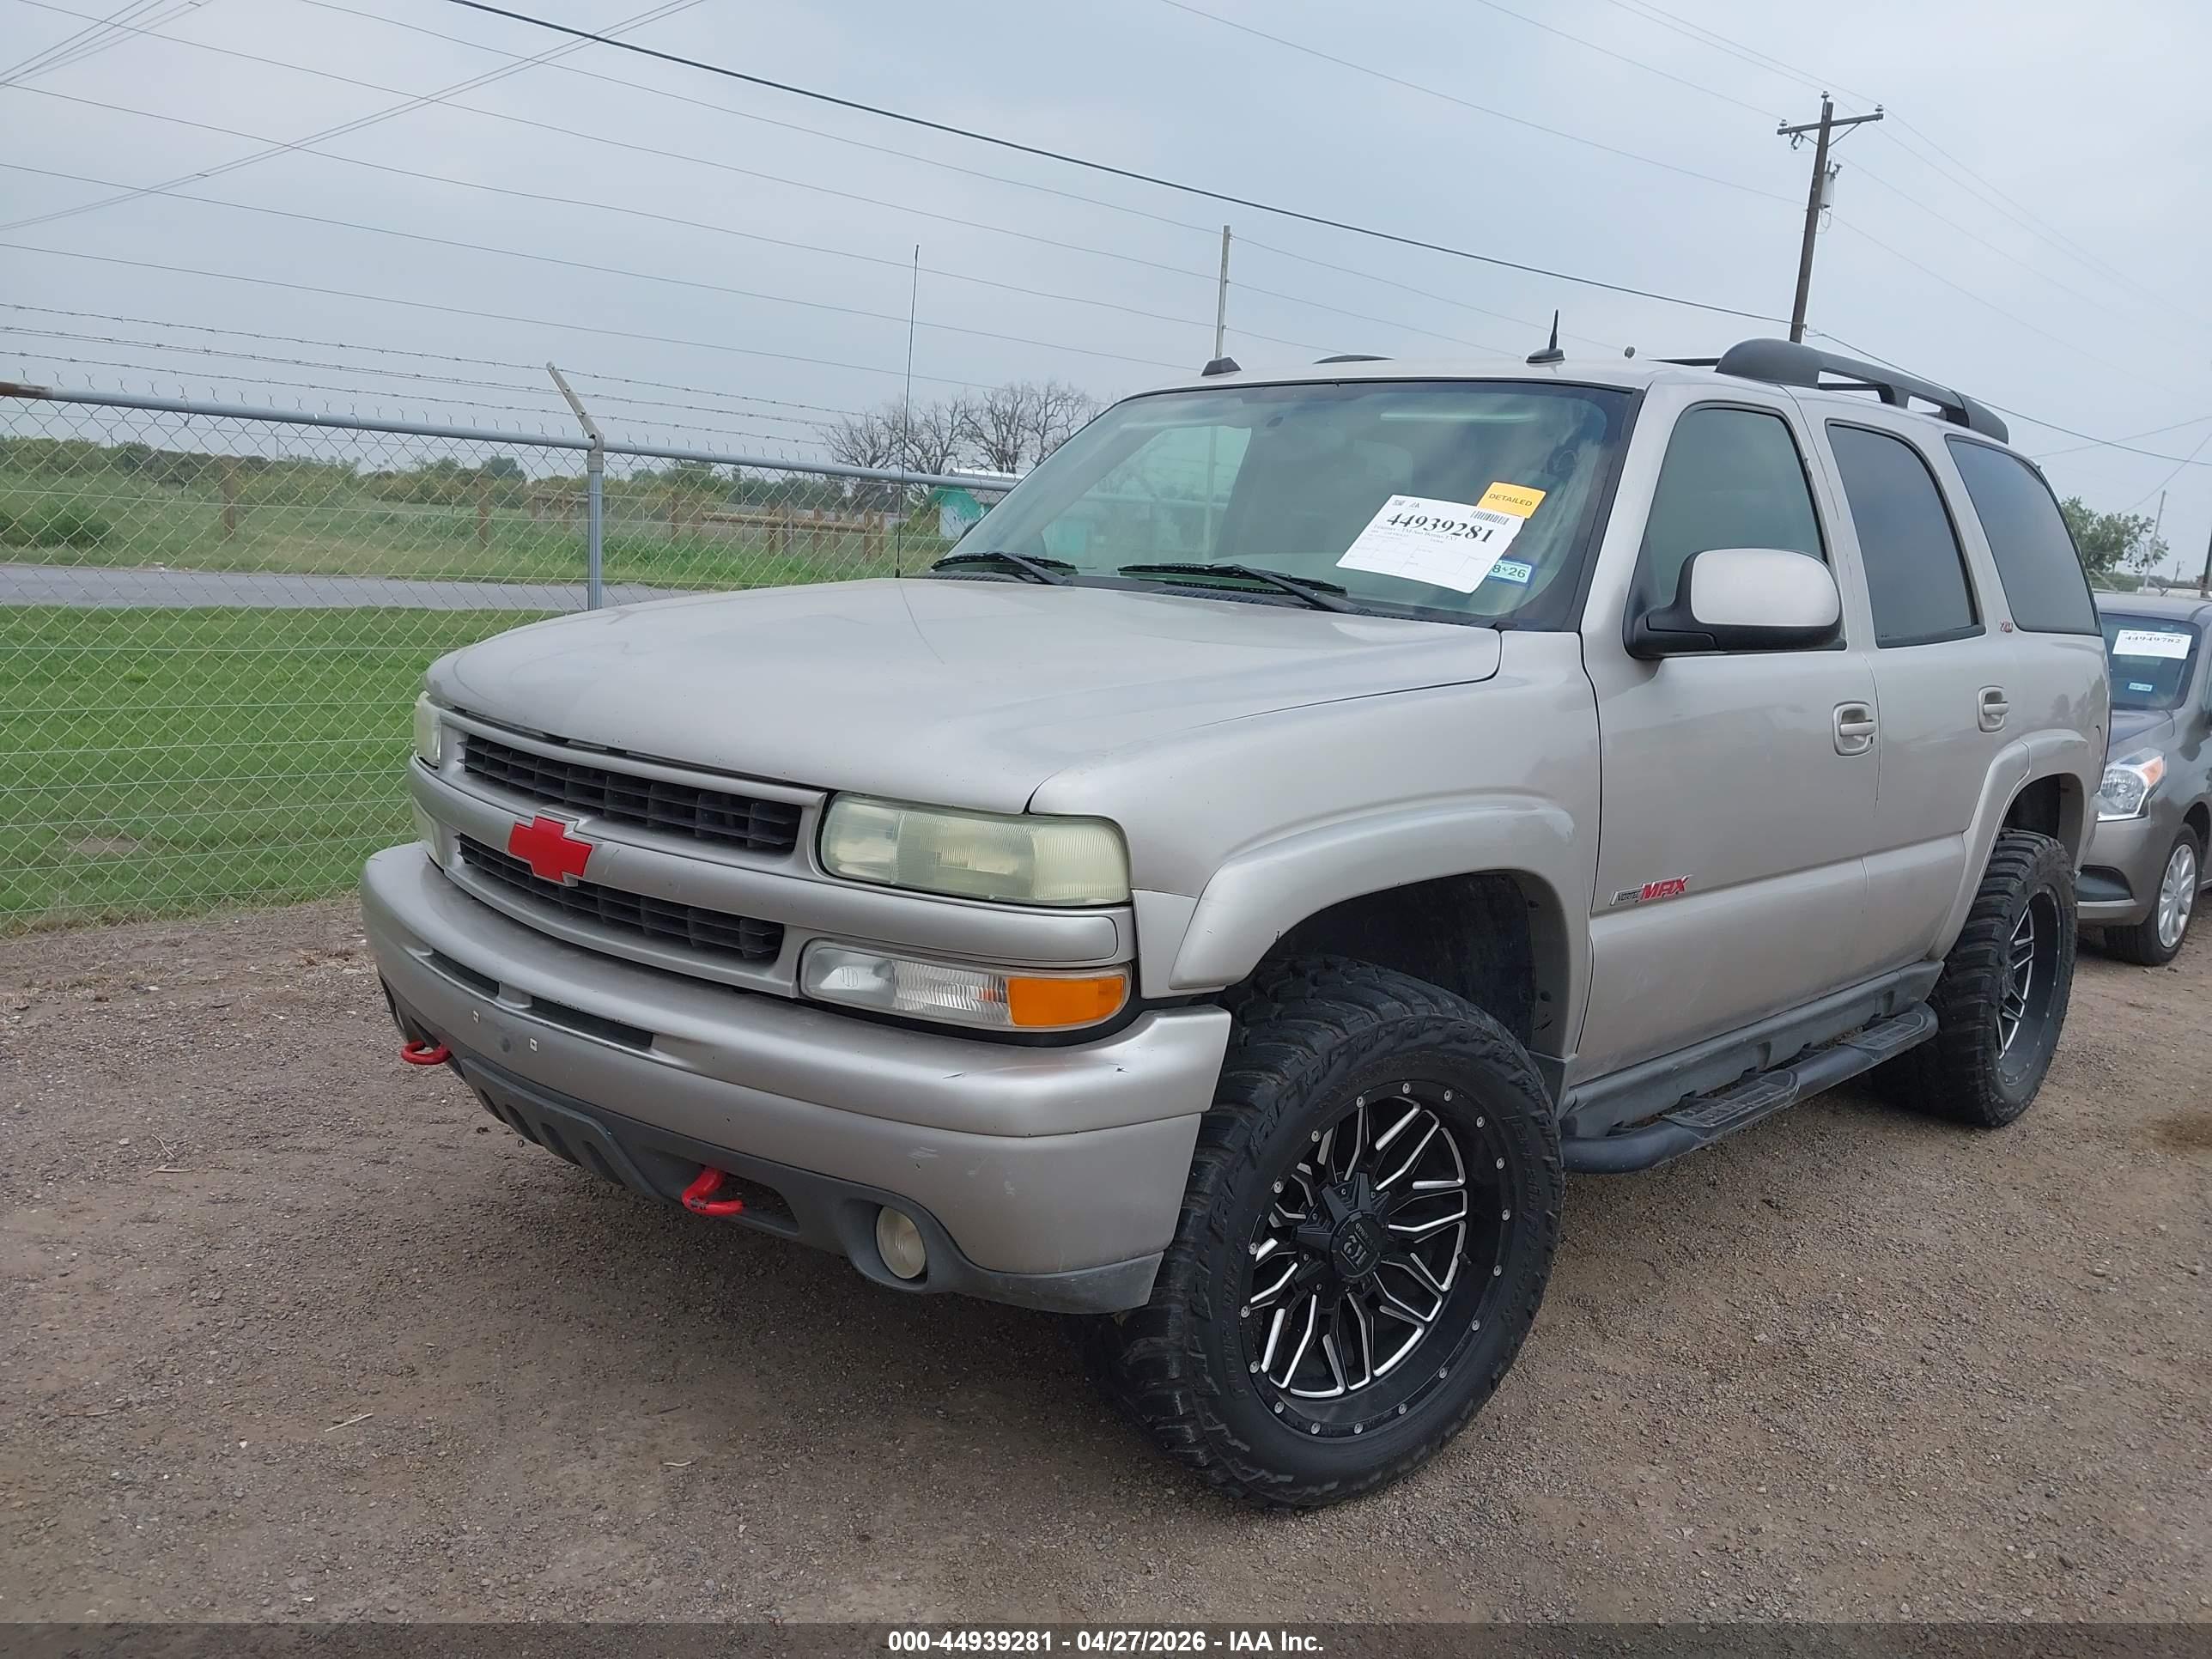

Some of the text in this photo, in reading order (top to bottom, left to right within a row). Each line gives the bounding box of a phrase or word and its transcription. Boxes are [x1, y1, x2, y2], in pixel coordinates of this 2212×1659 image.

[1488, 492, 1533, 507] DETAILED
[1386, 512, 1495, 544] 44939281
[1640, 876, 1691, 901] MAX
